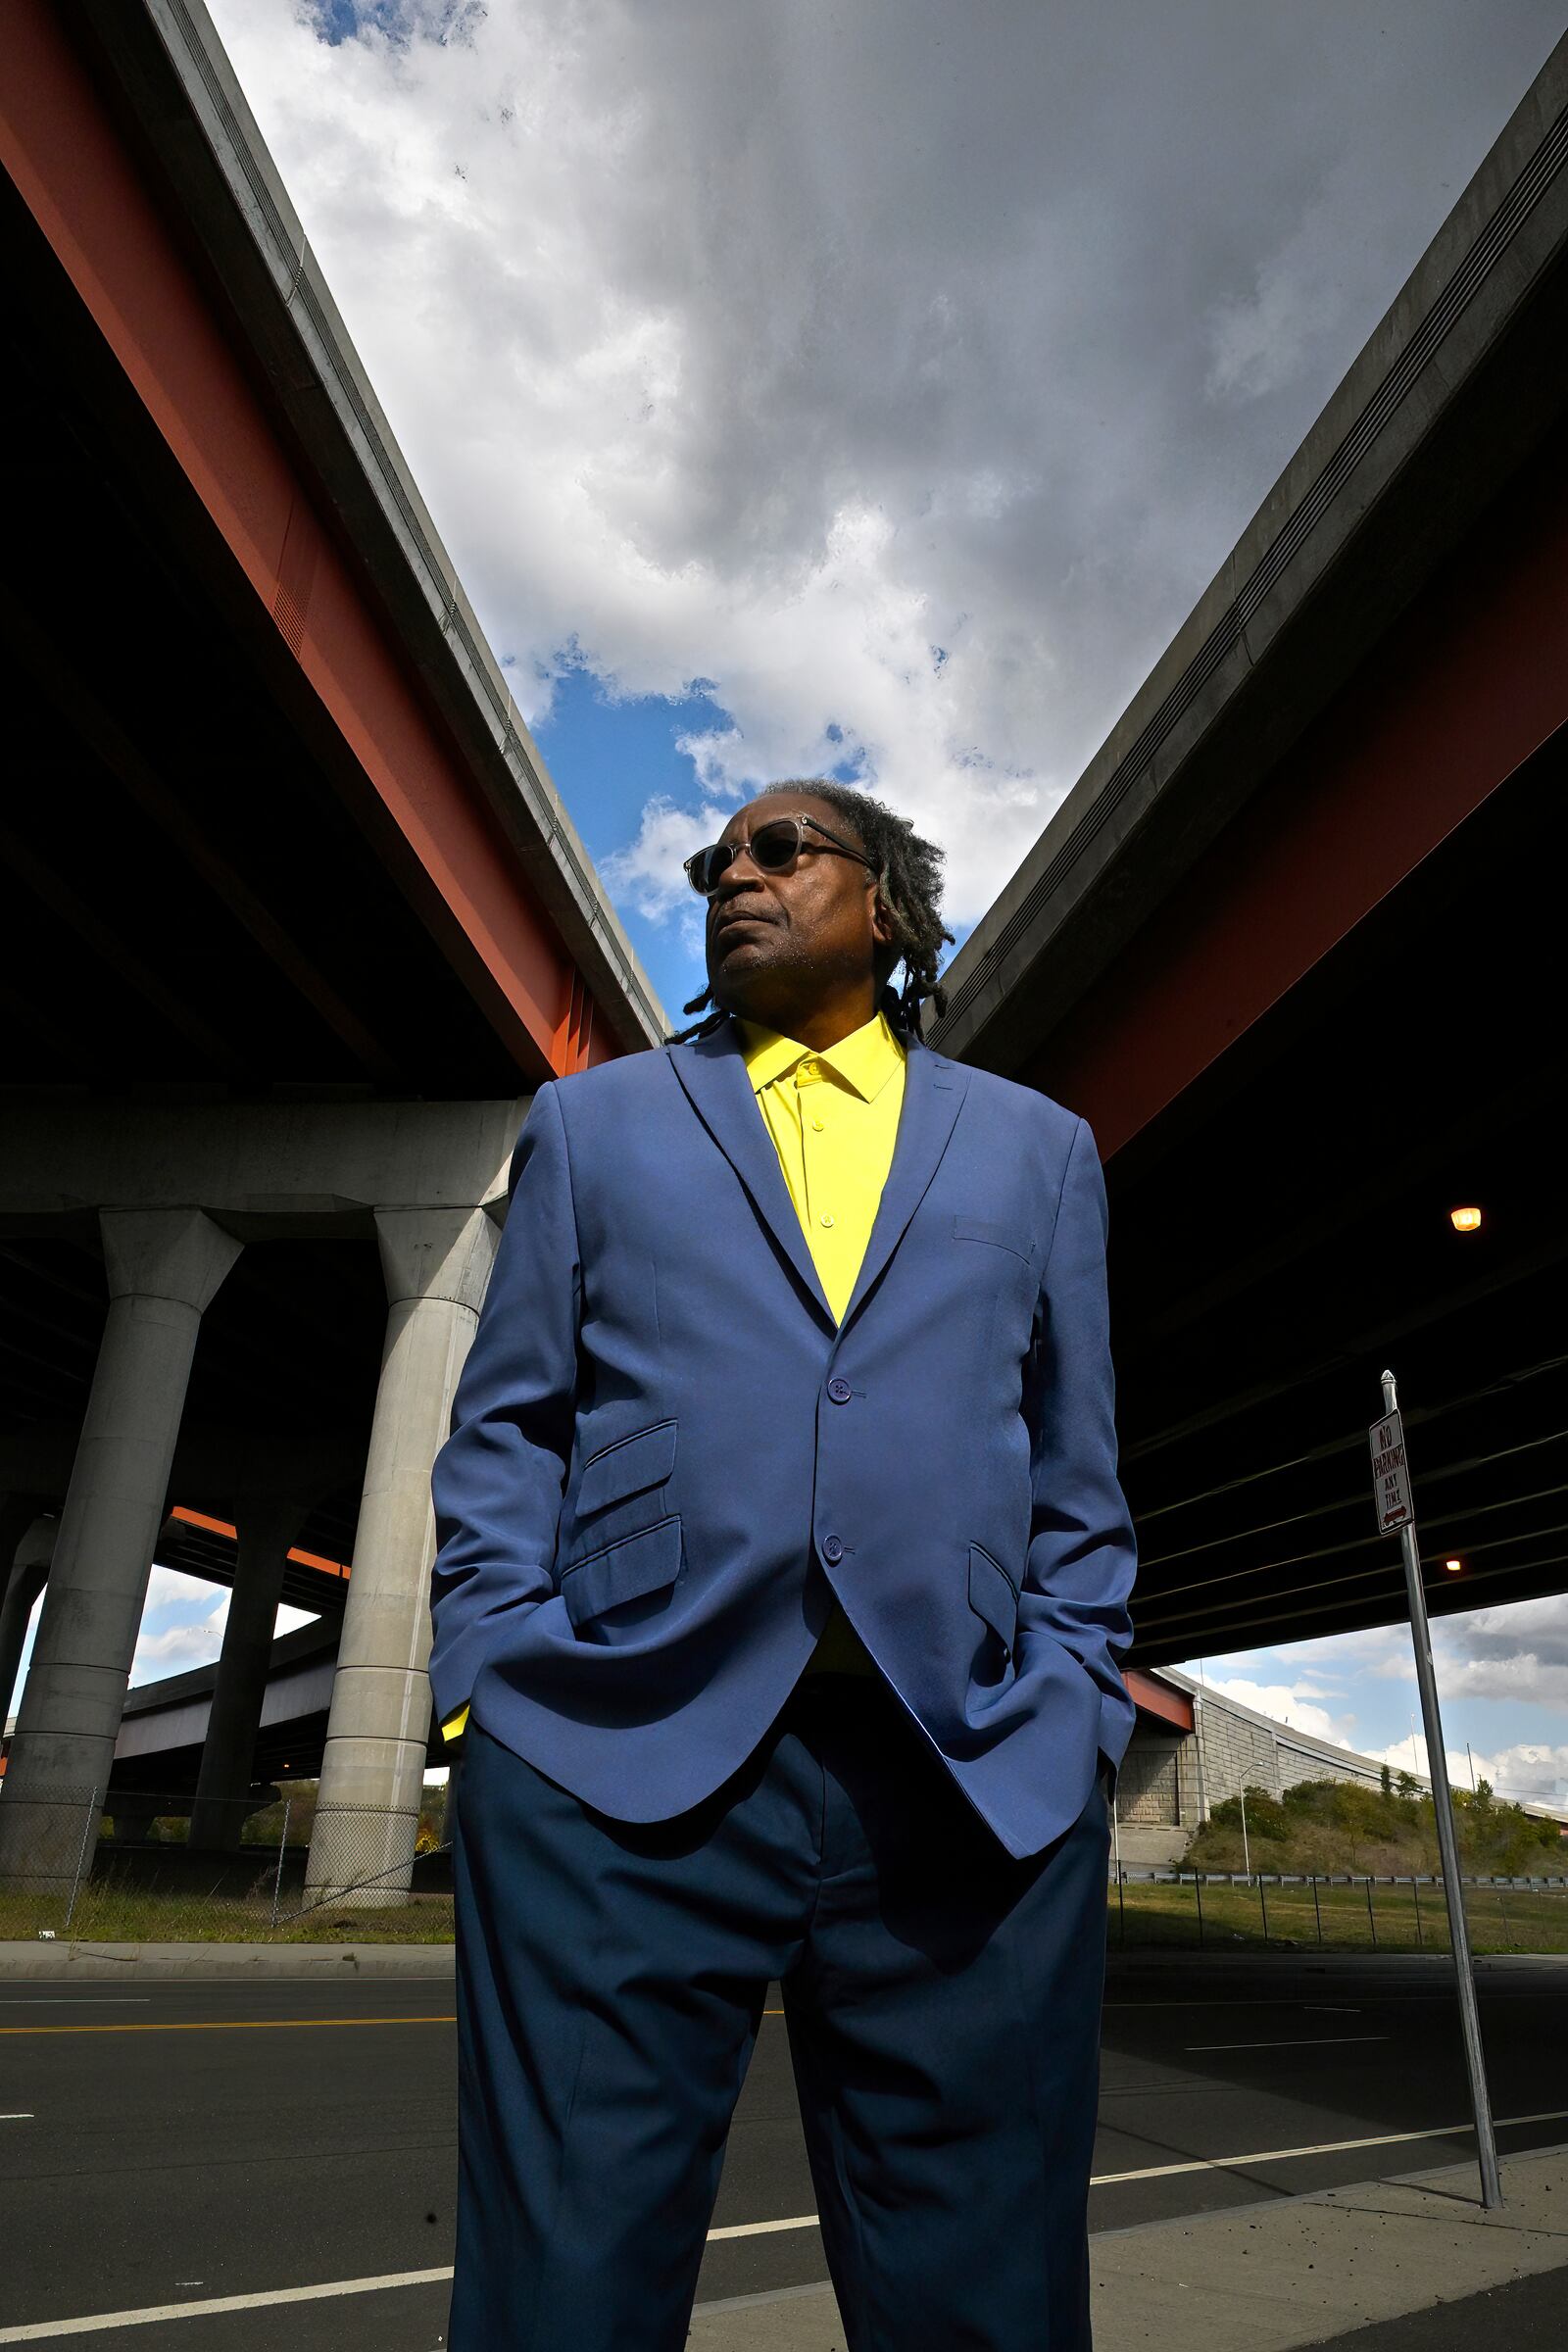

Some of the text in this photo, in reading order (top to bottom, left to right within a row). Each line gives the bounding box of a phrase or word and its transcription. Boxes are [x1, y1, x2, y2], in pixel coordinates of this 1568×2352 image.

[1379, 1424, 1393, 1451] NO
[1373, 1445, 1404, 1479] PARKING
[1385, 1473, 1397, 1492] ANY
[1385, 1489, 1401, 1509] TIME
